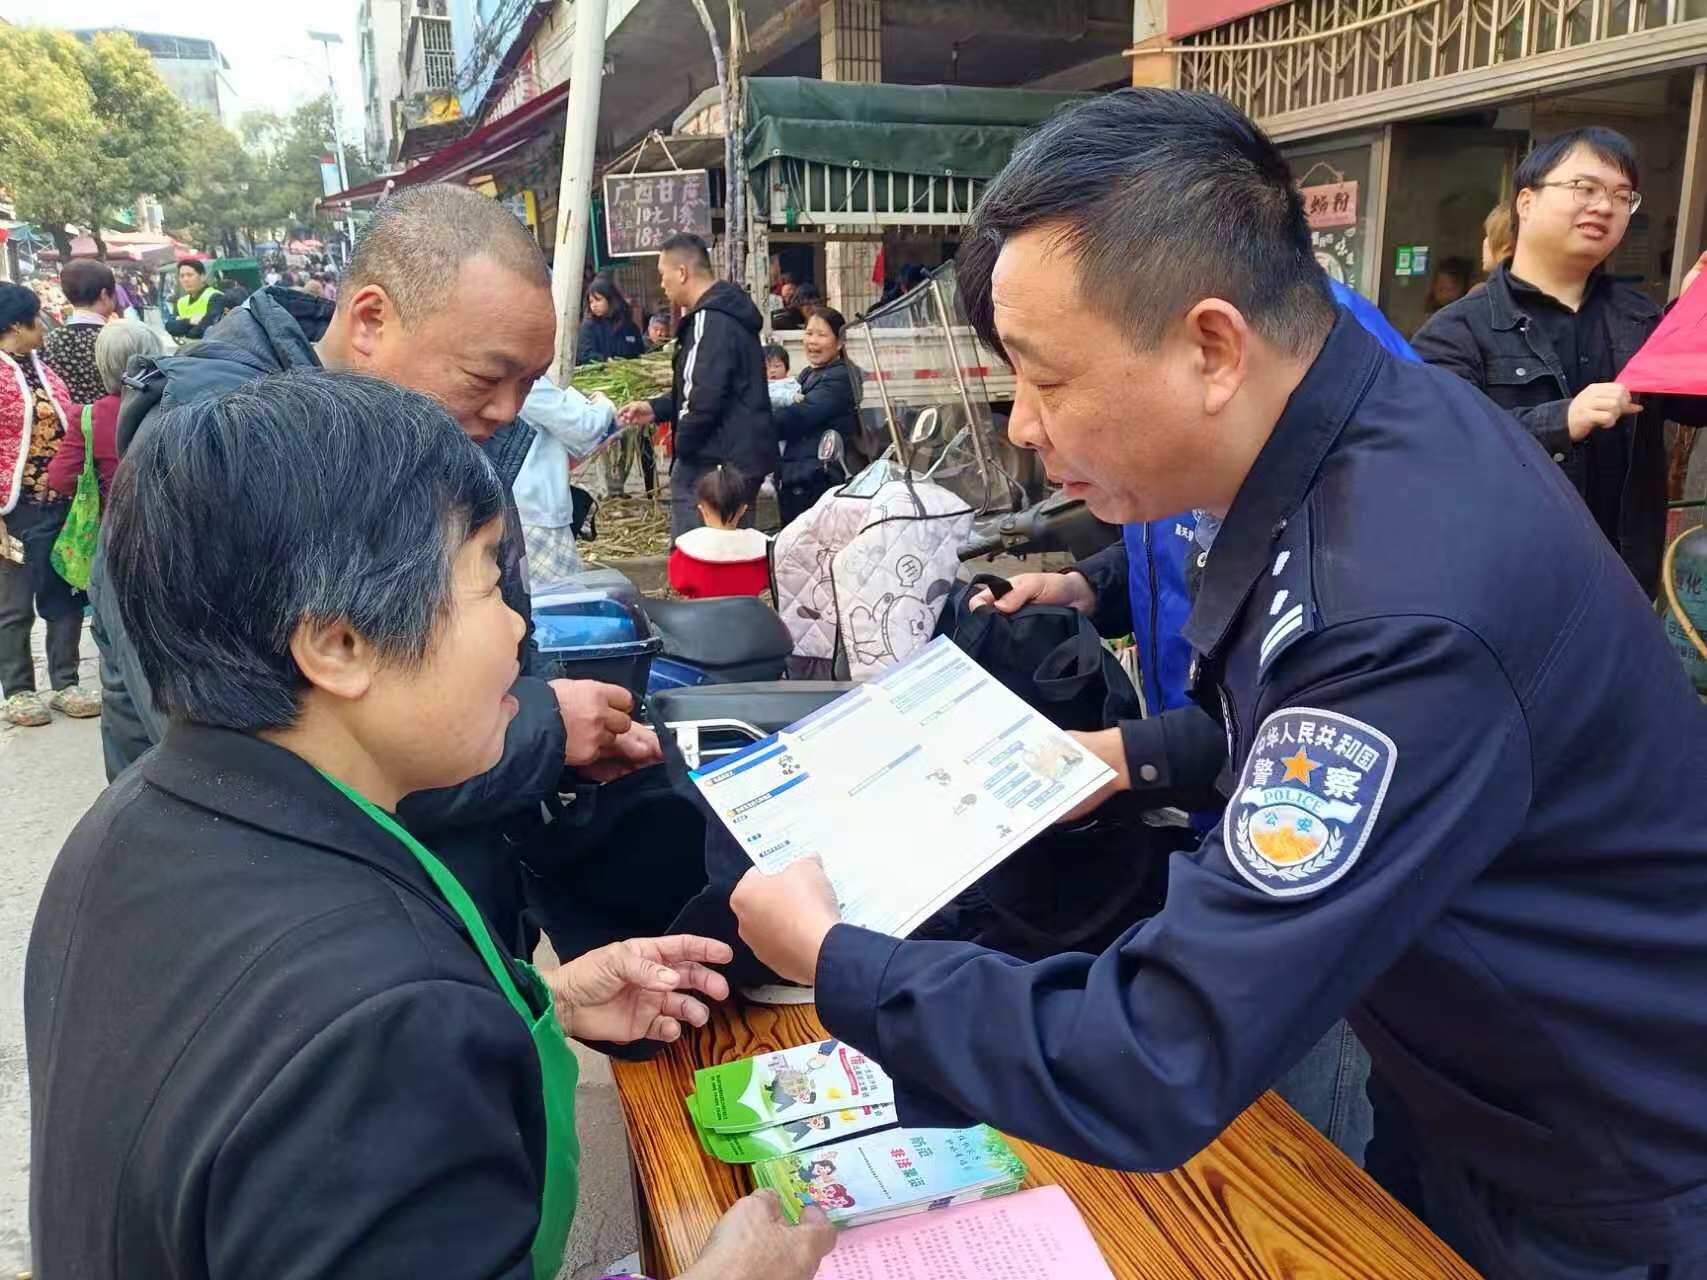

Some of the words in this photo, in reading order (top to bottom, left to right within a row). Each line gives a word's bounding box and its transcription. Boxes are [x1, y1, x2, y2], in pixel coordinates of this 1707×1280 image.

[614, 176, 706, 206] 广西甘蔗
[902, 559, 918, 578] Hi
[1256, 721, 1379, 773] 中华人民共和国
[1252, 757, 1275, 787] 警
[1323, 766, 1363, 801] 察
[1263, 791, 1324, 813] POLICE
[909, 1135, 934, 1158] 防范
